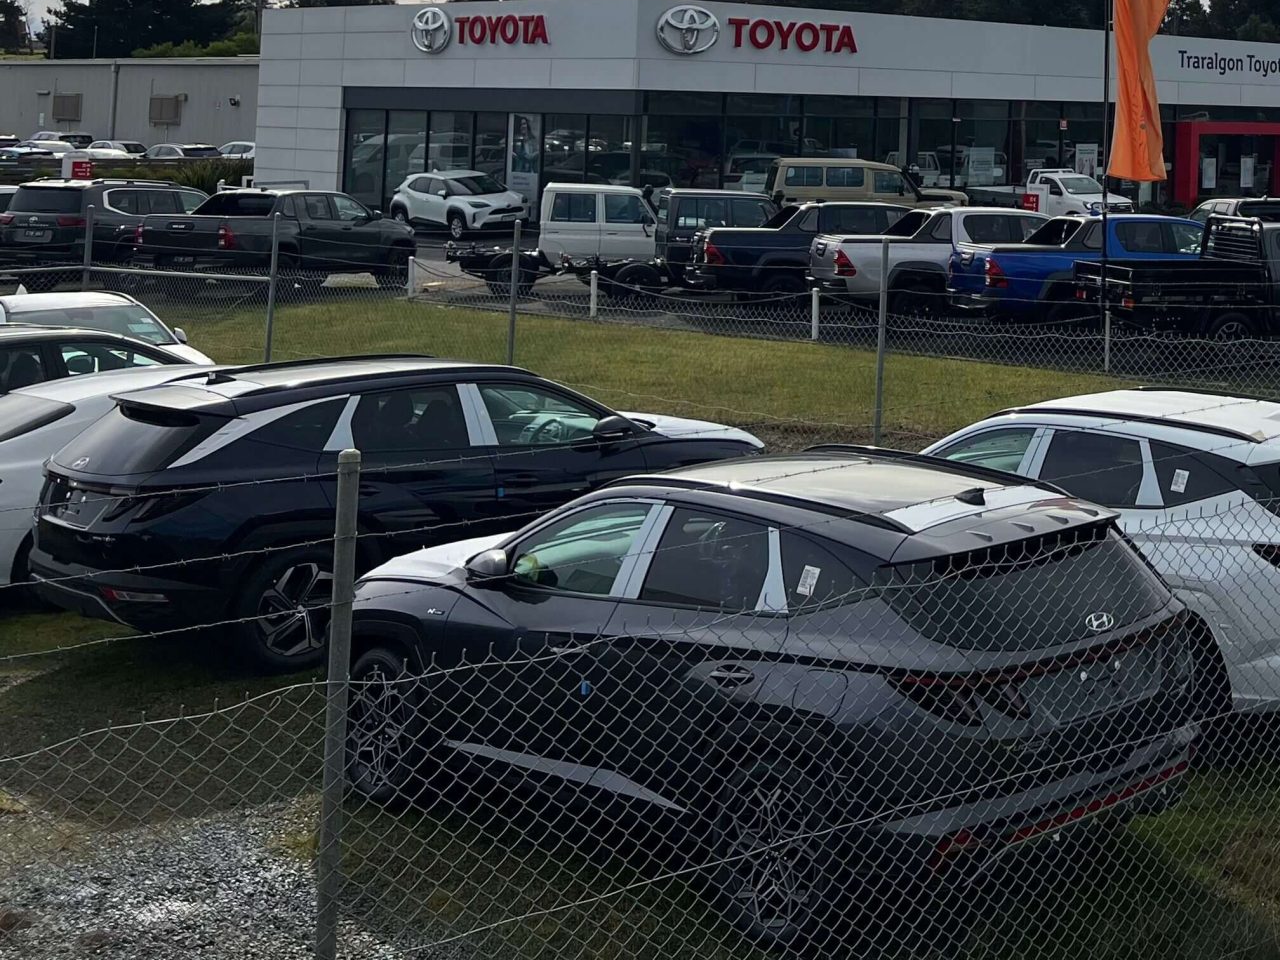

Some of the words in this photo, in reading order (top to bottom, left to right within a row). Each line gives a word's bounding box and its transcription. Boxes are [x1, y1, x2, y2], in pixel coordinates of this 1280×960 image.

[454, 14, 550, 45] TOYOTA
[728, 17, 858, 53] TOYOTA
[1178, 50, 1243, 75] Traralgon
